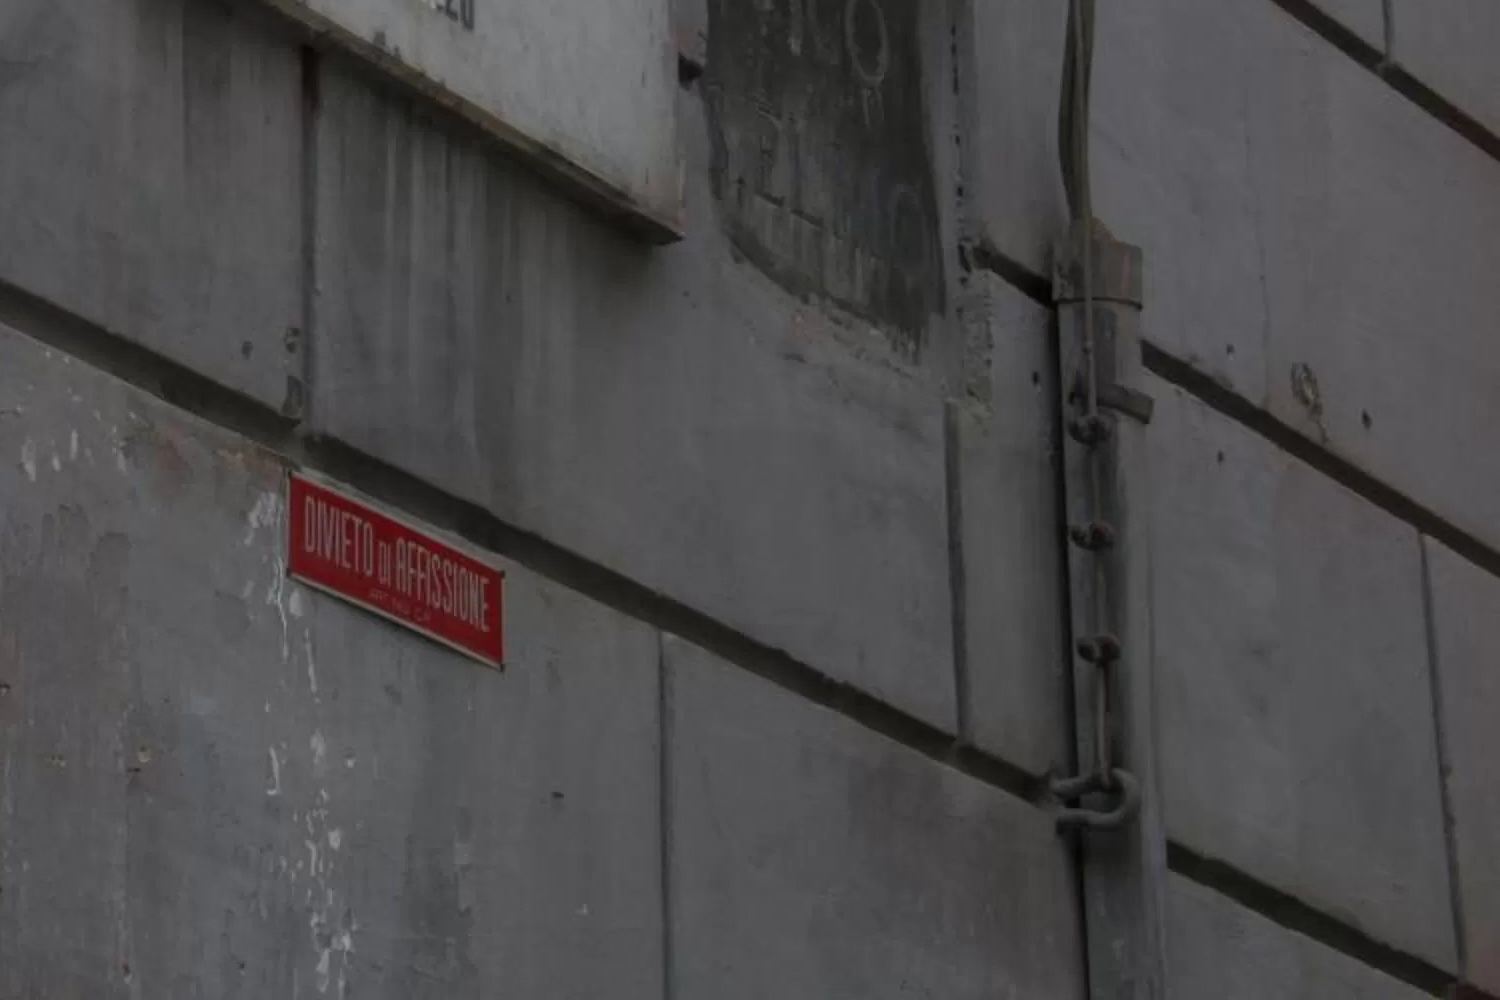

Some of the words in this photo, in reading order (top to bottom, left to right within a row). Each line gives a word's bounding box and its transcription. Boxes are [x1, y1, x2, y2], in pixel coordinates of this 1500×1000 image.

[304, 496, 374, 578] DIVIETO
[378, 540, 393, 590] DI
[395, 535, 490, 633] AFFISSIONE
